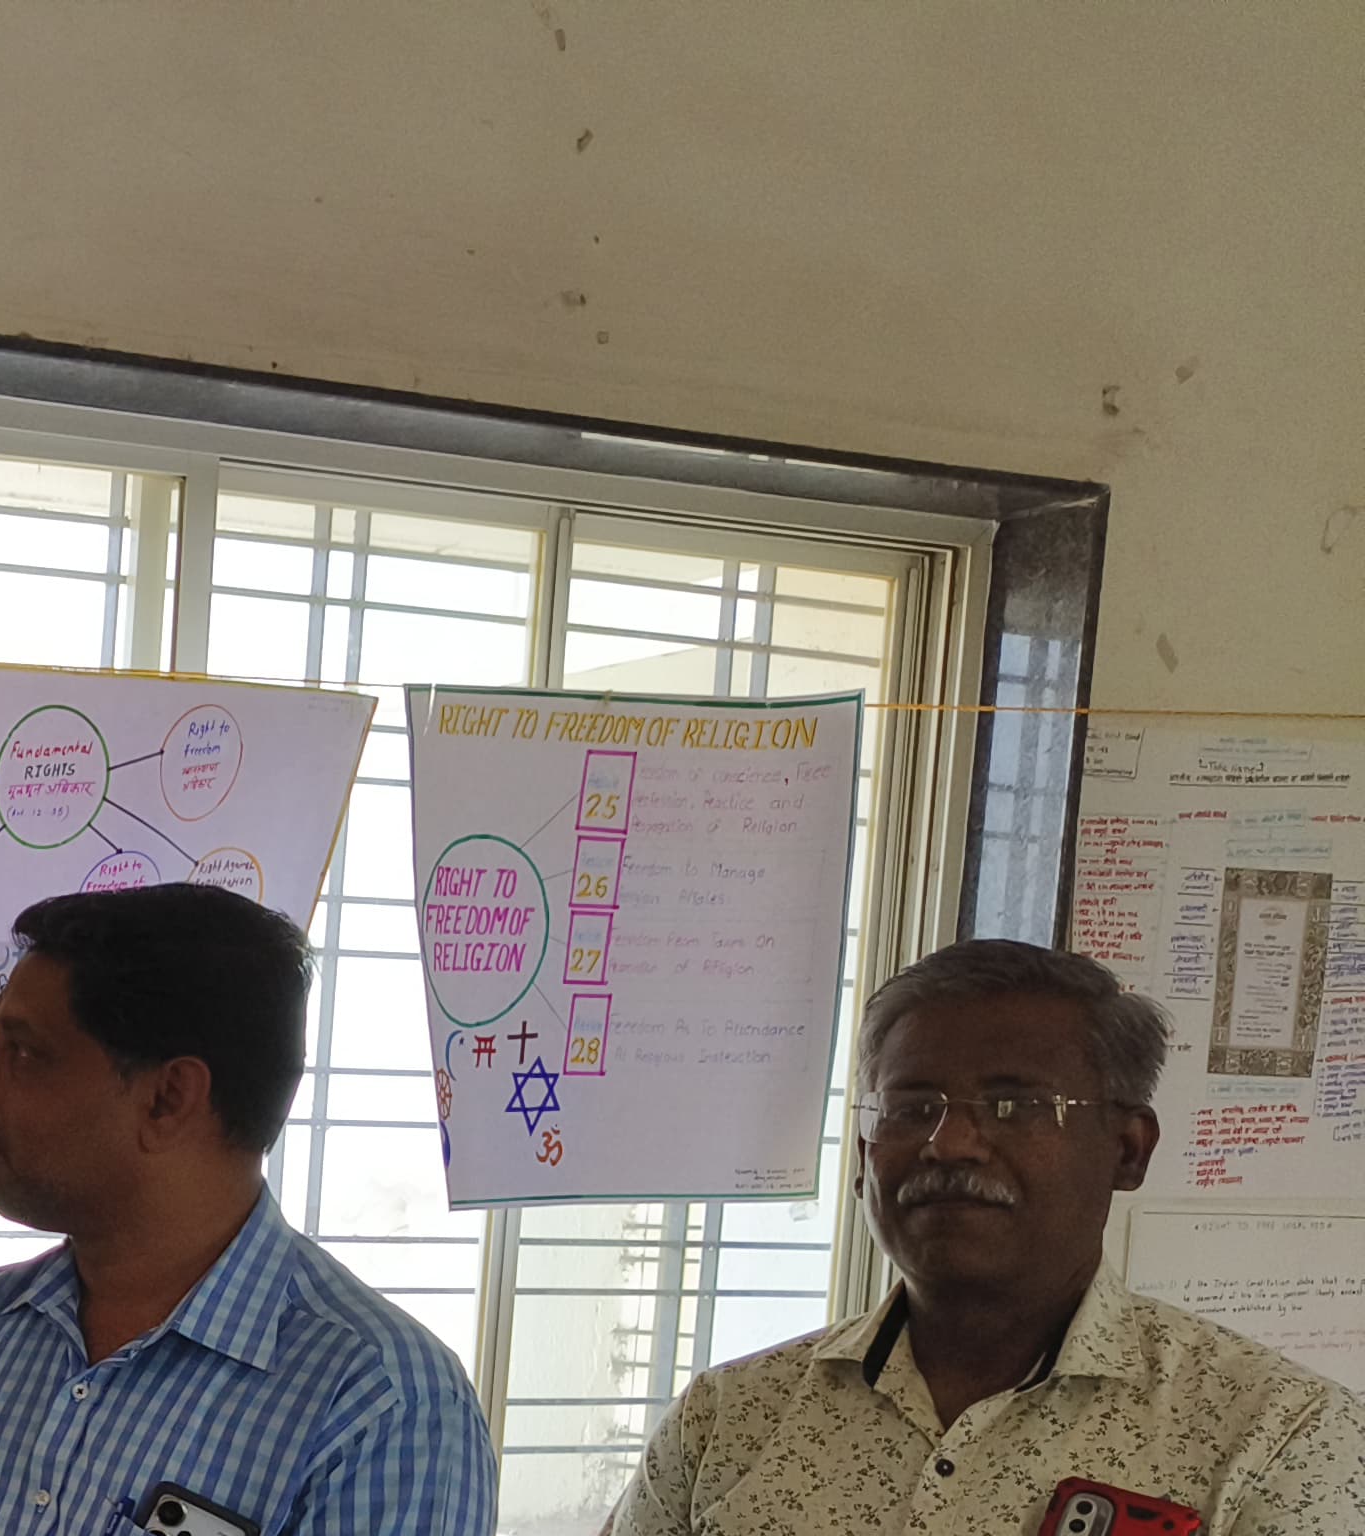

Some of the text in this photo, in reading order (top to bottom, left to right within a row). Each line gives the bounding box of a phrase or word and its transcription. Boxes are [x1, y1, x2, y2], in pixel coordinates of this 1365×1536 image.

[438, 704, 819, 751] RIGHT TO FREEDOM OF RELIGION
[24, 762, 77, 780] RIGHTS
[584, 792, 619, 820] 25
[433, 865, 519, 899] RIGHT TO
[576, 872, 609, 899] 26
[432, 942, 528, 974] RELIGION
[569, 947, 603, 973] 27
[569, 1036, 600, 1066] 28
